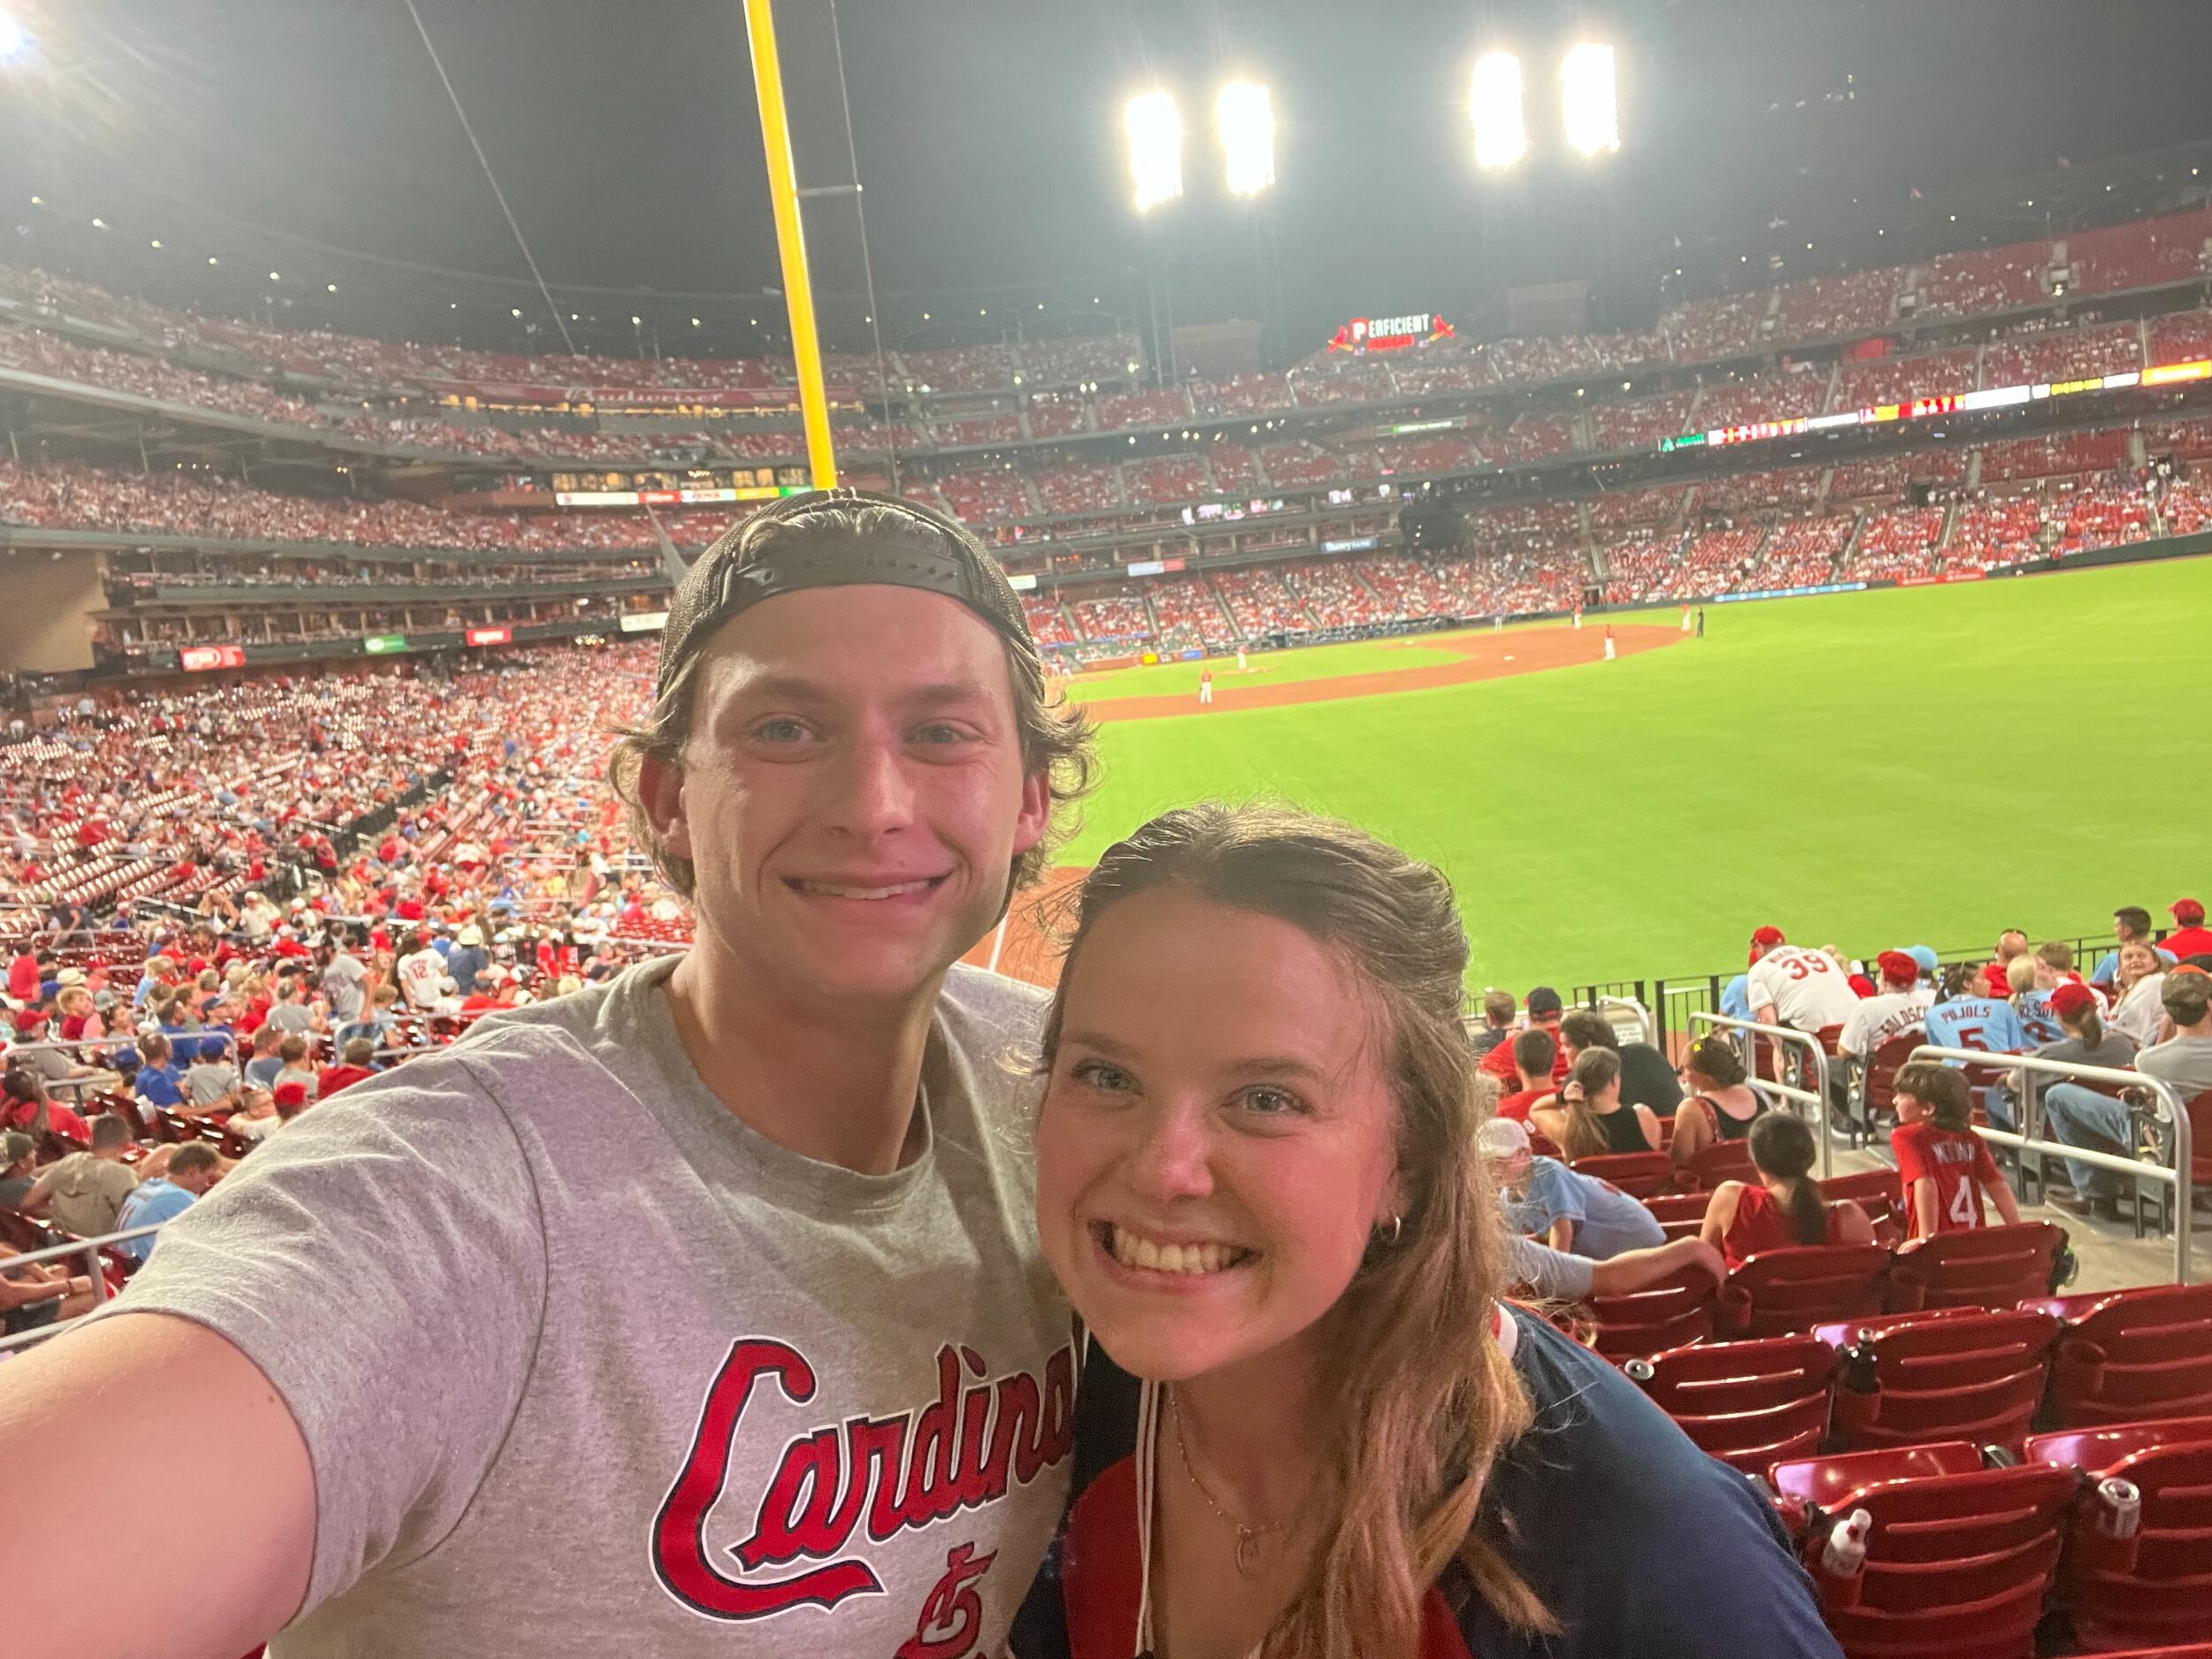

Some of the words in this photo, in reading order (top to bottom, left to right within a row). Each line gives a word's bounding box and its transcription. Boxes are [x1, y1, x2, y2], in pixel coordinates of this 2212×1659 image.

[1781, 955, 1828, 980] 39
[1941, 1005, 1991, 1025] PUJOLS
[1958, 1026, 1989, 1052] 5
[1949, 1175, 1978, 1230] 4
